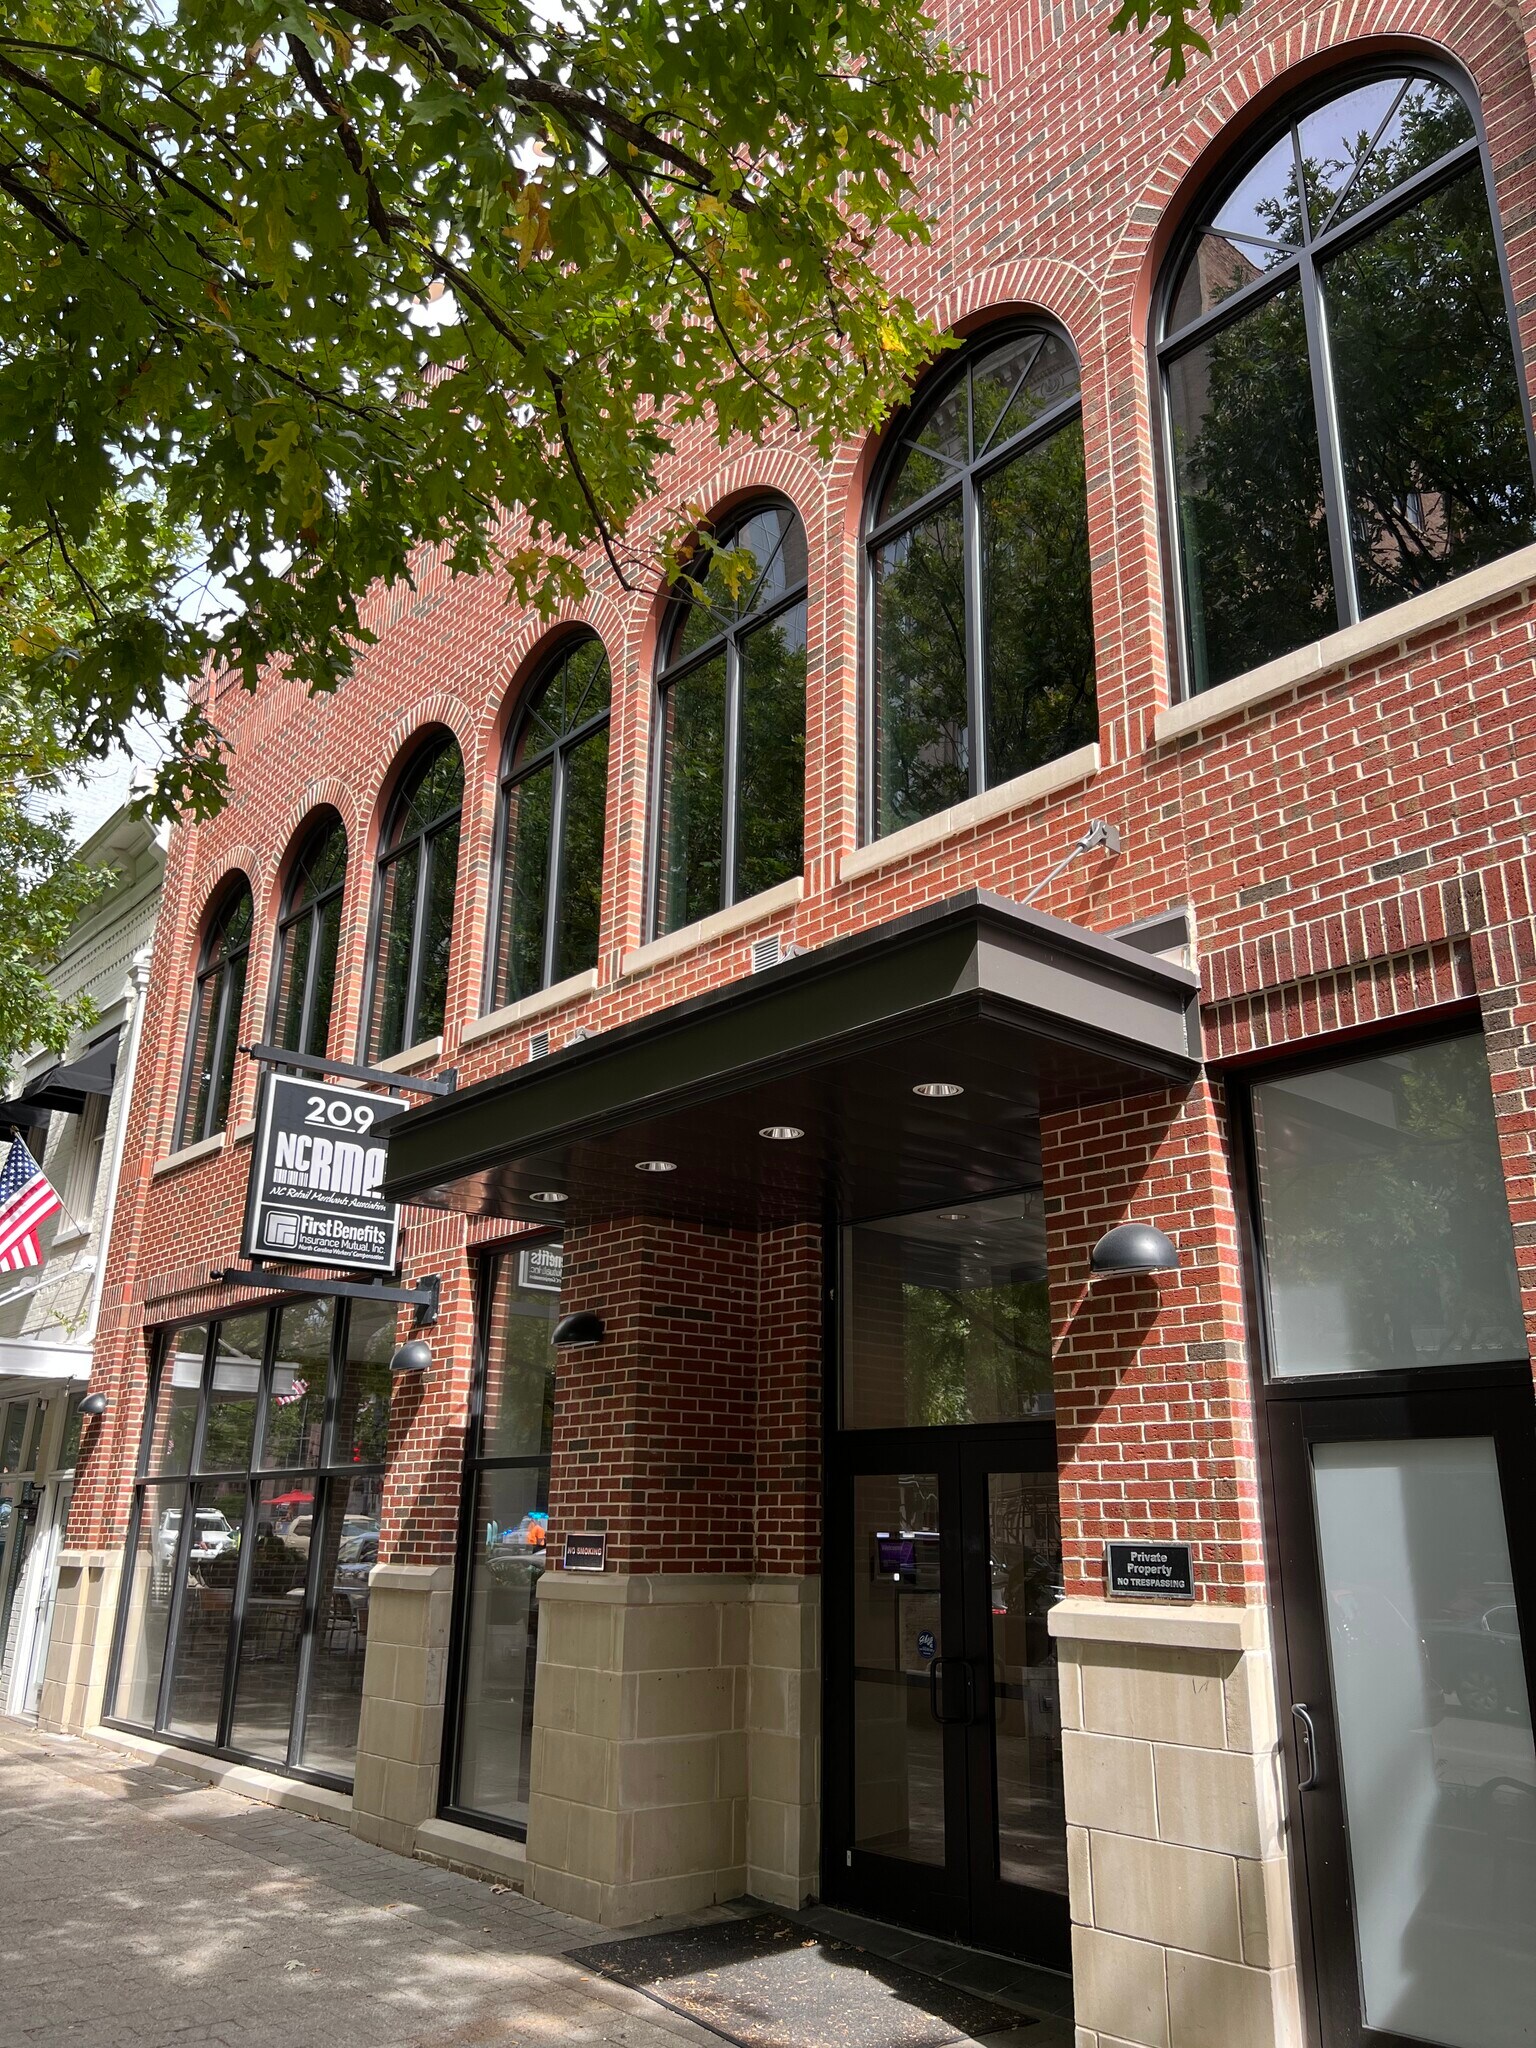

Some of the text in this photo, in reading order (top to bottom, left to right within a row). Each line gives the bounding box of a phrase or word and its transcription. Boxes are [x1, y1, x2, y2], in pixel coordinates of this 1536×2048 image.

[304, 1096, 375, 1134] 209
[274, 1131, 386, 1199] NCRMA
[269, 1186, 386, 1211] NC Retail Merchants Association
[299, 1234, 386, 1254] Insurance Mutual, Inc.
[313, 1246, 333, 1254] Carolina
[576, 1547, 602, 1555] SMOKING
[1130, 1551, 1168, 1562] Private
[1127, 1563, 1172, 1576] Property
[1117, 1577, 1185, 1588] NO TRESPASSING
